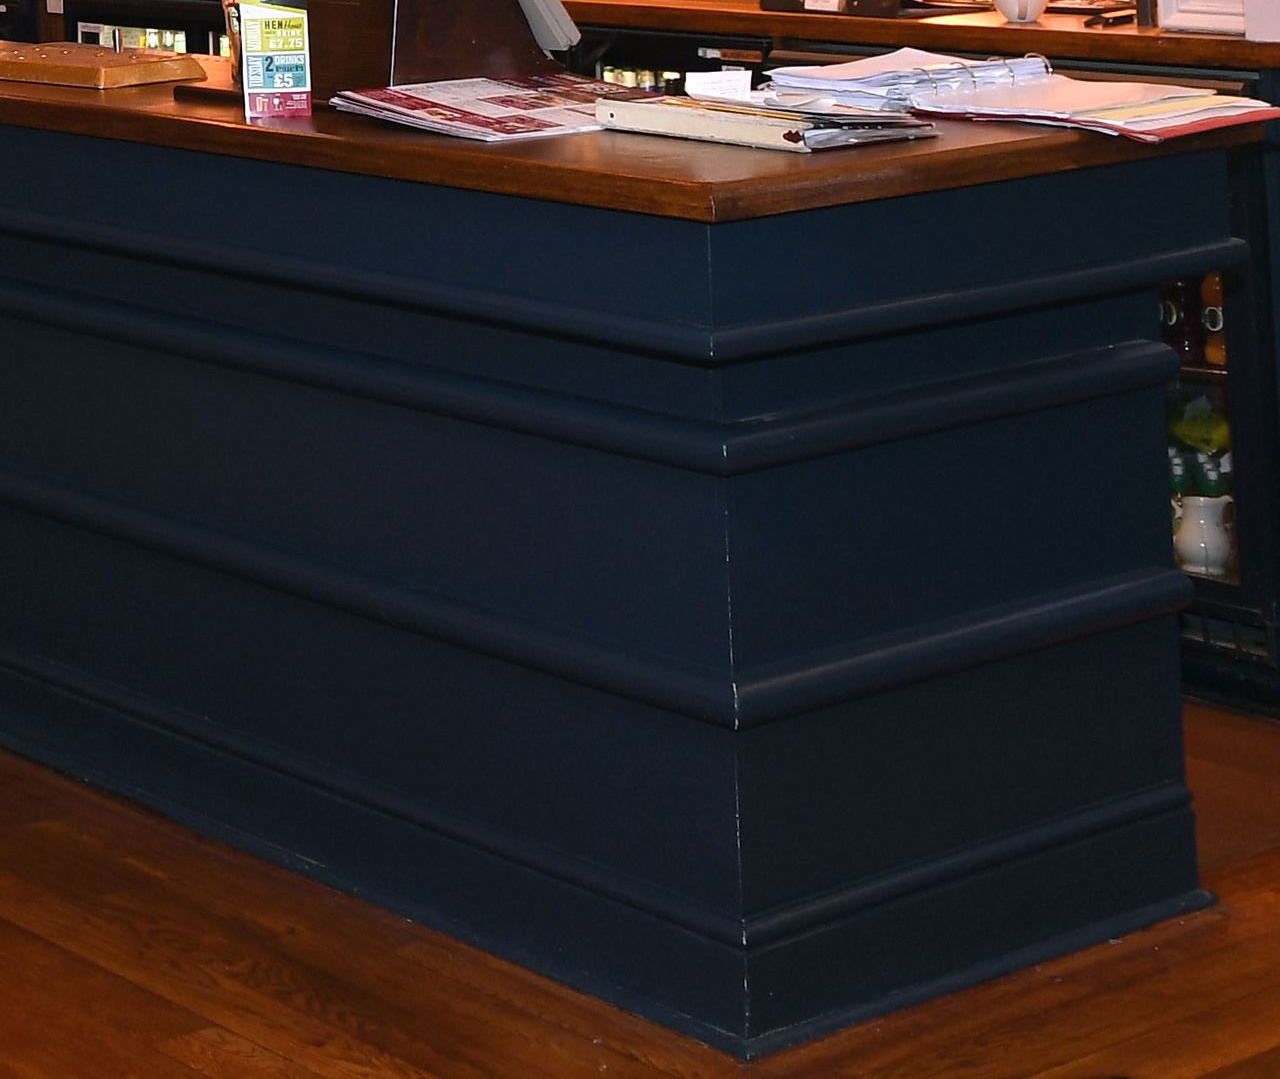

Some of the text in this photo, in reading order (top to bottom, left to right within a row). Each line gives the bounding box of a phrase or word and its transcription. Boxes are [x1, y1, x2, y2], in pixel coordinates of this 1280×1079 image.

[269, 37, 303, 50] £7.75
[265, 55, 274, 73] 2
[274, 55, 305, 65] DRINKS
[273, 72, 294, 88] £5
